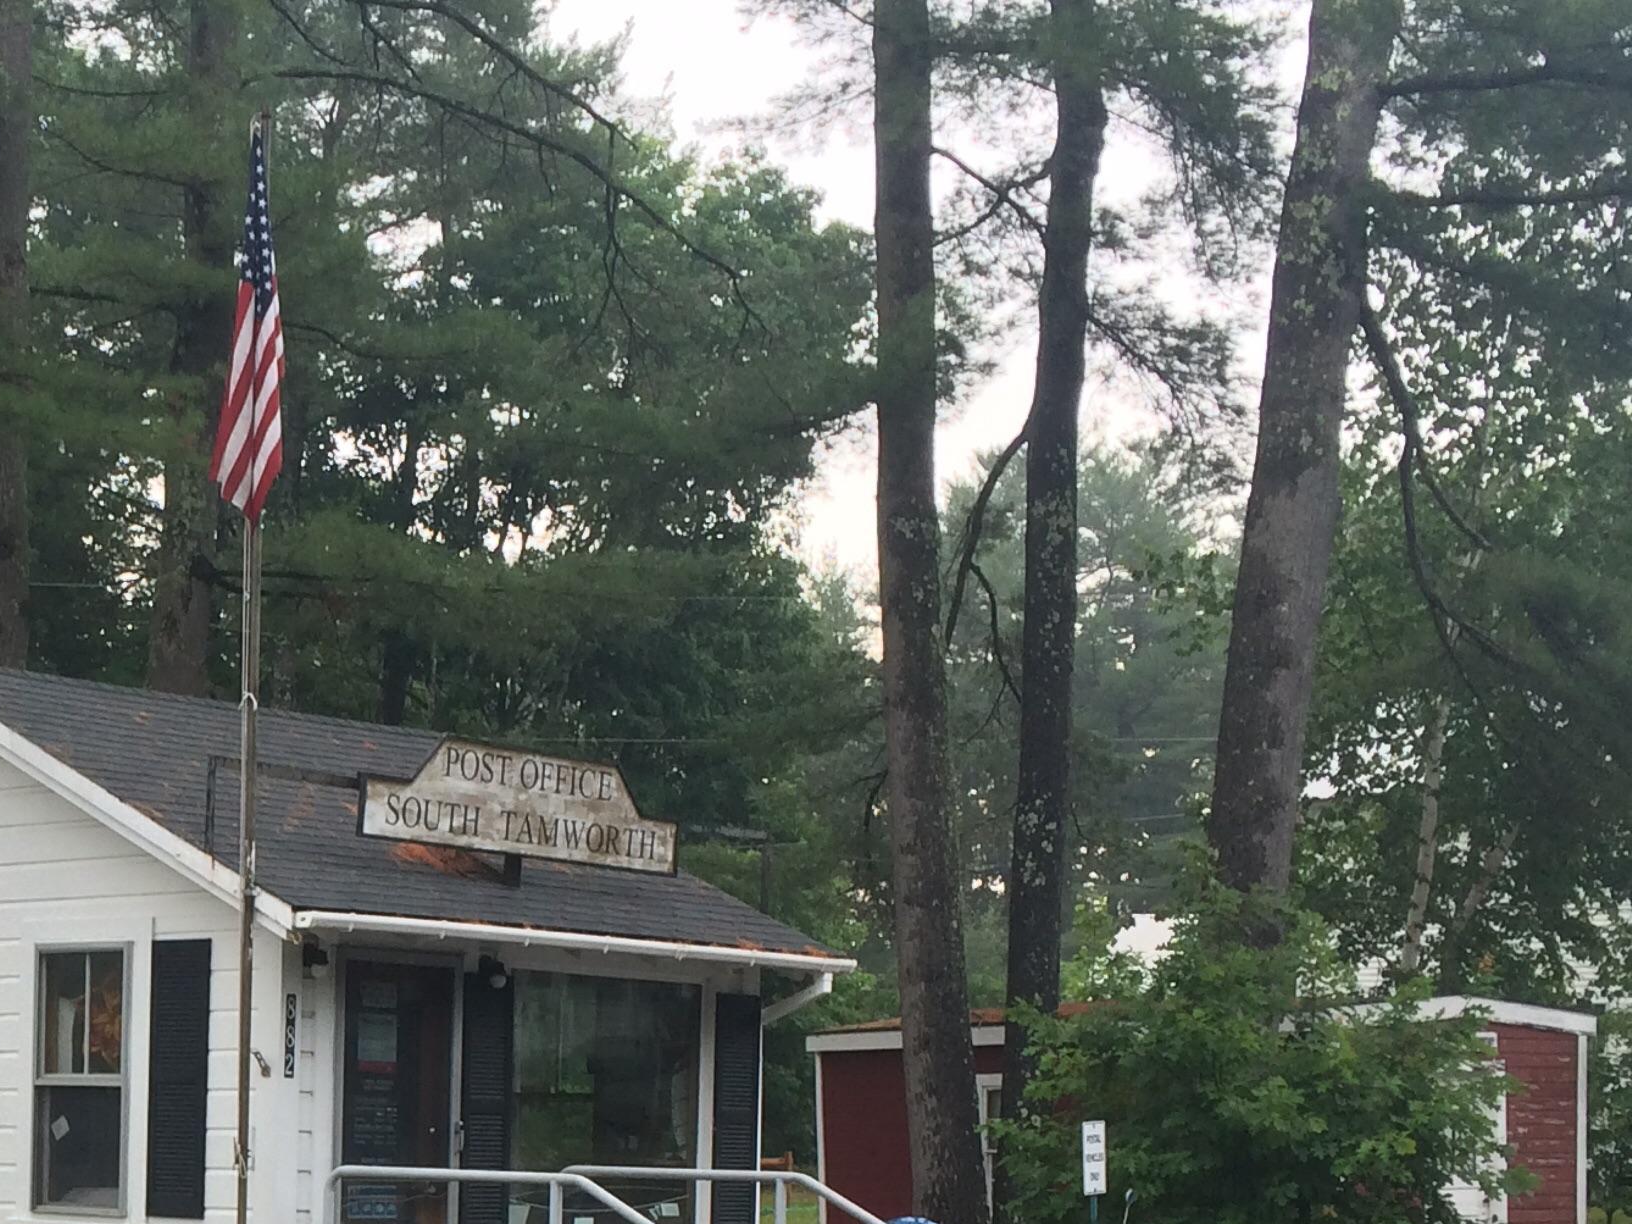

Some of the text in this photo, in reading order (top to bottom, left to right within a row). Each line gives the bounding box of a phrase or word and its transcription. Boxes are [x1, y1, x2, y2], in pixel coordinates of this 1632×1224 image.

[445, 746, 613, 801] POST OFFICE
[385, 793, 656, 860] SOUTH TAMWORTH
